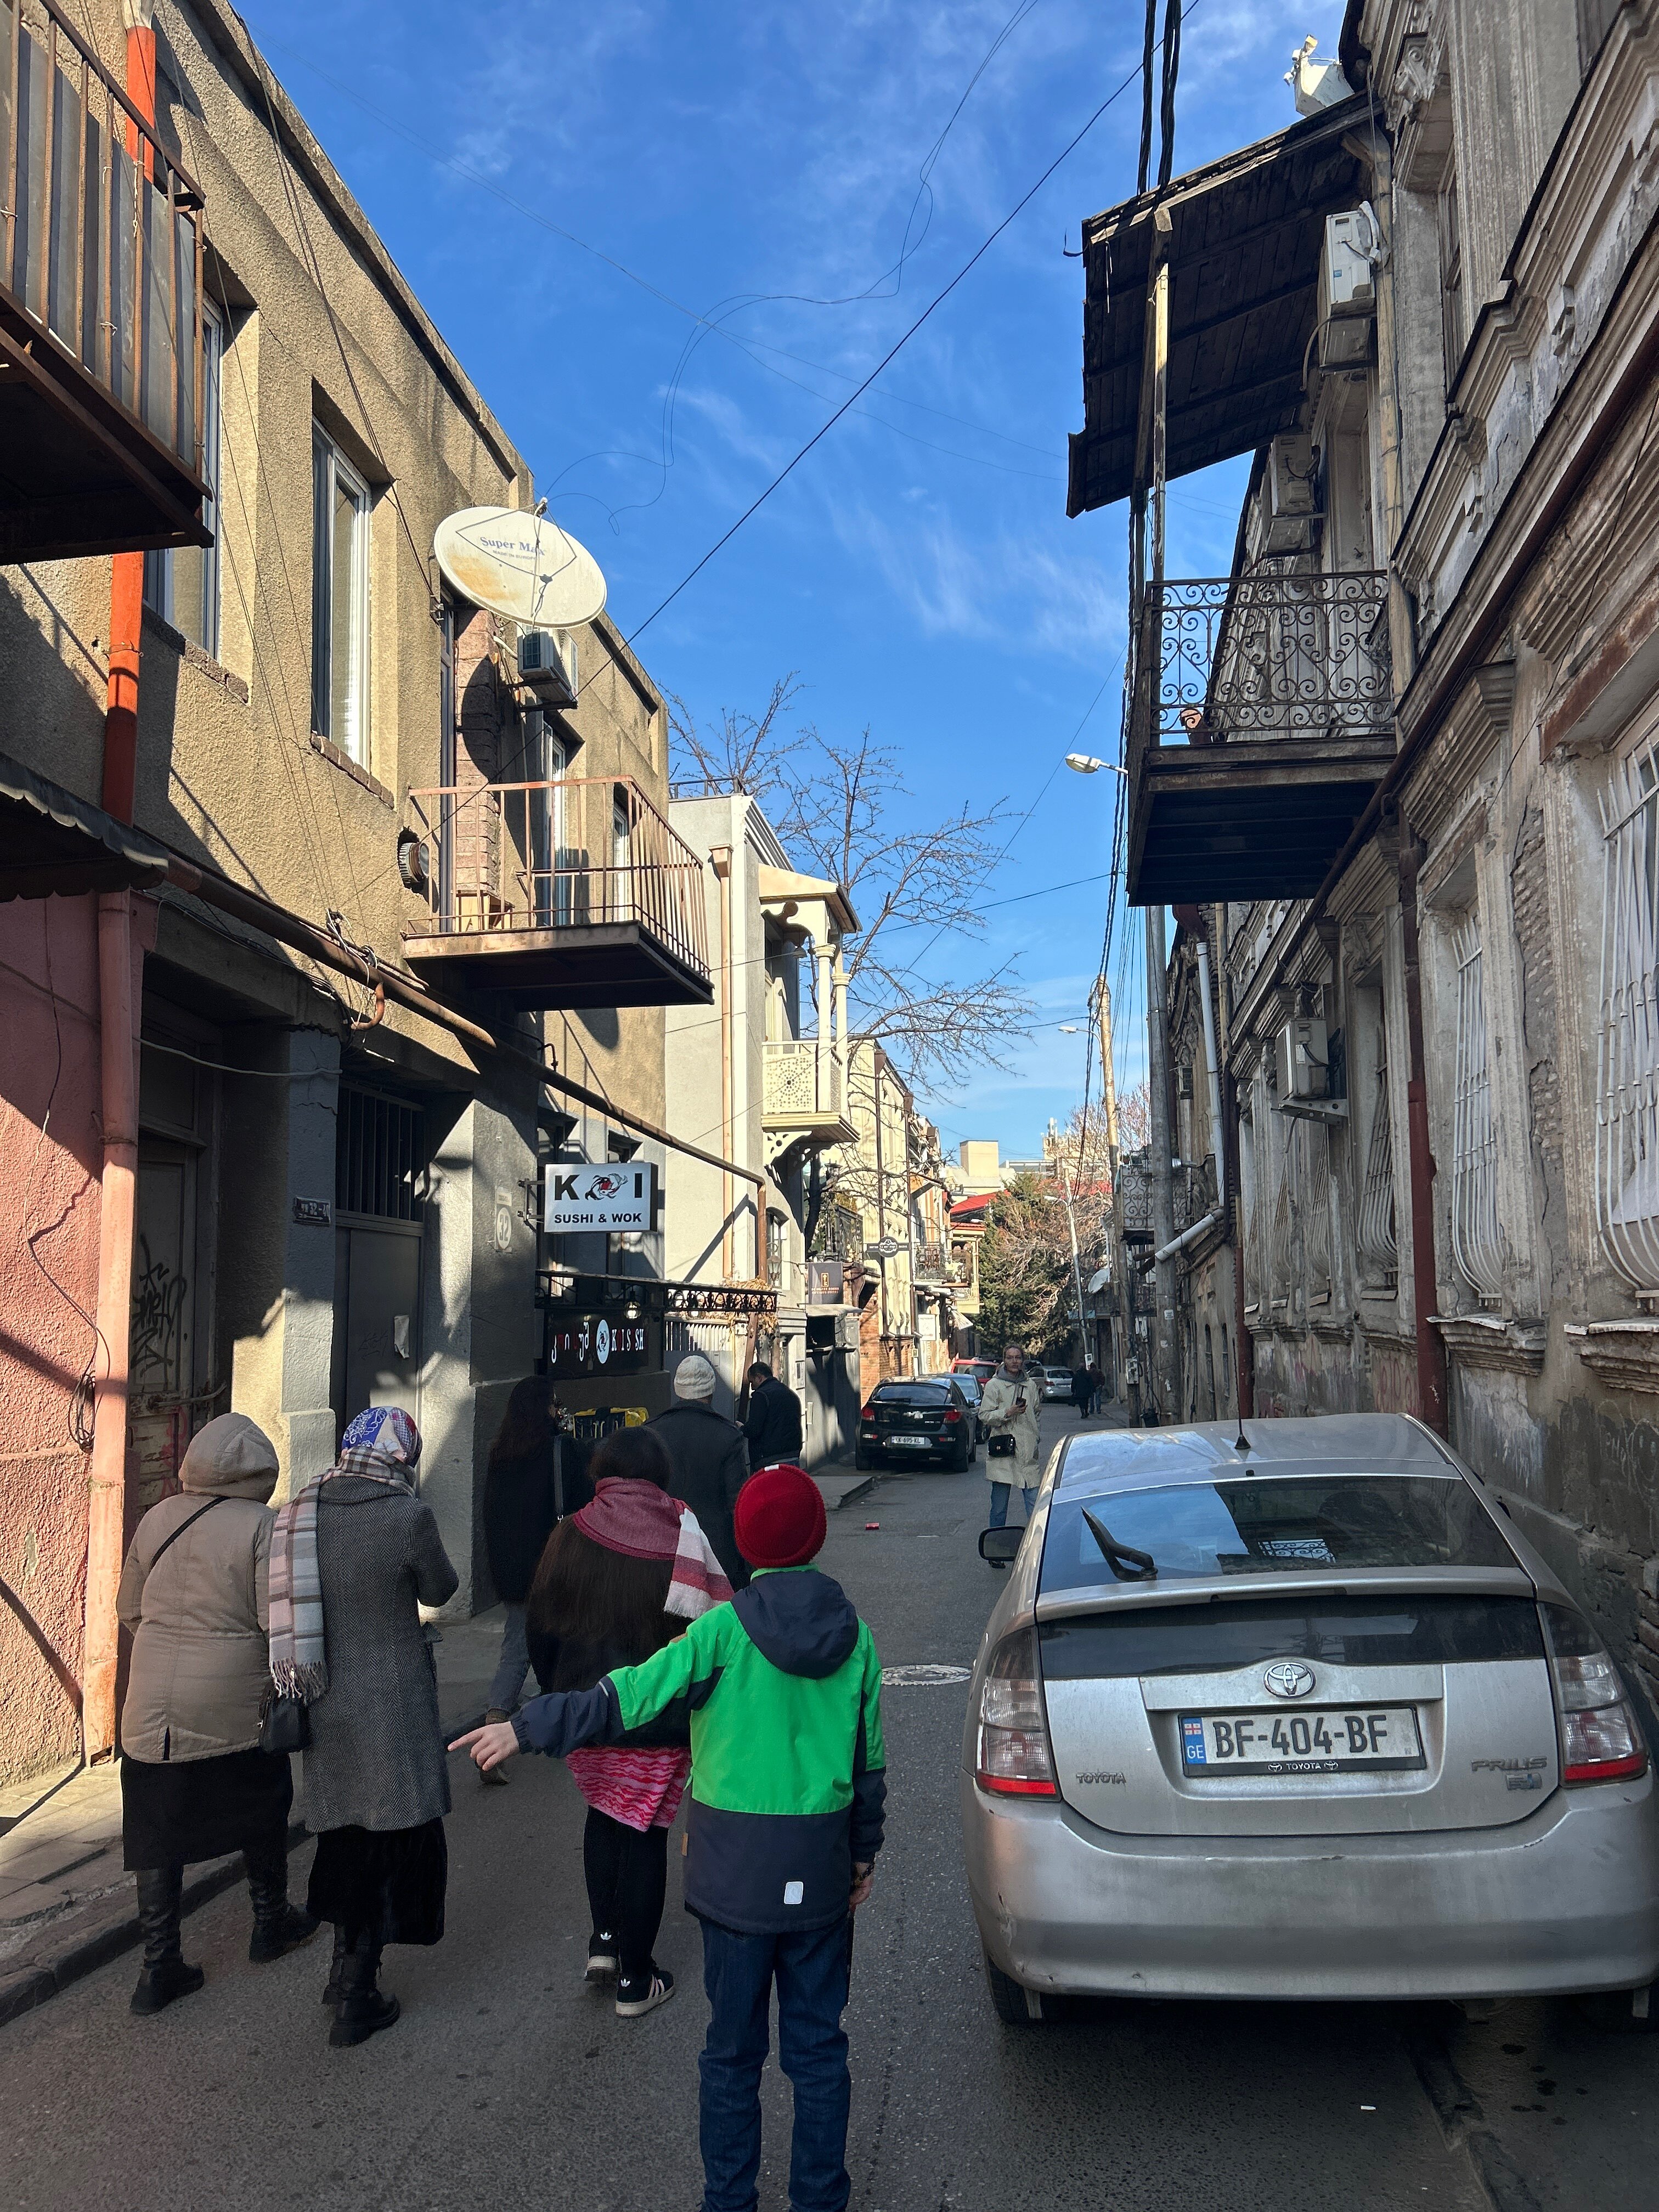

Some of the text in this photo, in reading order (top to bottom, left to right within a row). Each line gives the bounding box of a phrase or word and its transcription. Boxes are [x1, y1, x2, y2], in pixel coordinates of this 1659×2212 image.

[480, 537, 516, 549] Super
[499, 1214, 508, 1241] 32
[554, 1213, 642, 1223] SUSHI & WOK
[1187, 1714, 1387, 1759] GE BF-404-BF
[1076, 1756, 1547, 1784] TOYOTA PRIUS
[1286, 1762, 1321, 1771] TOYOTA
